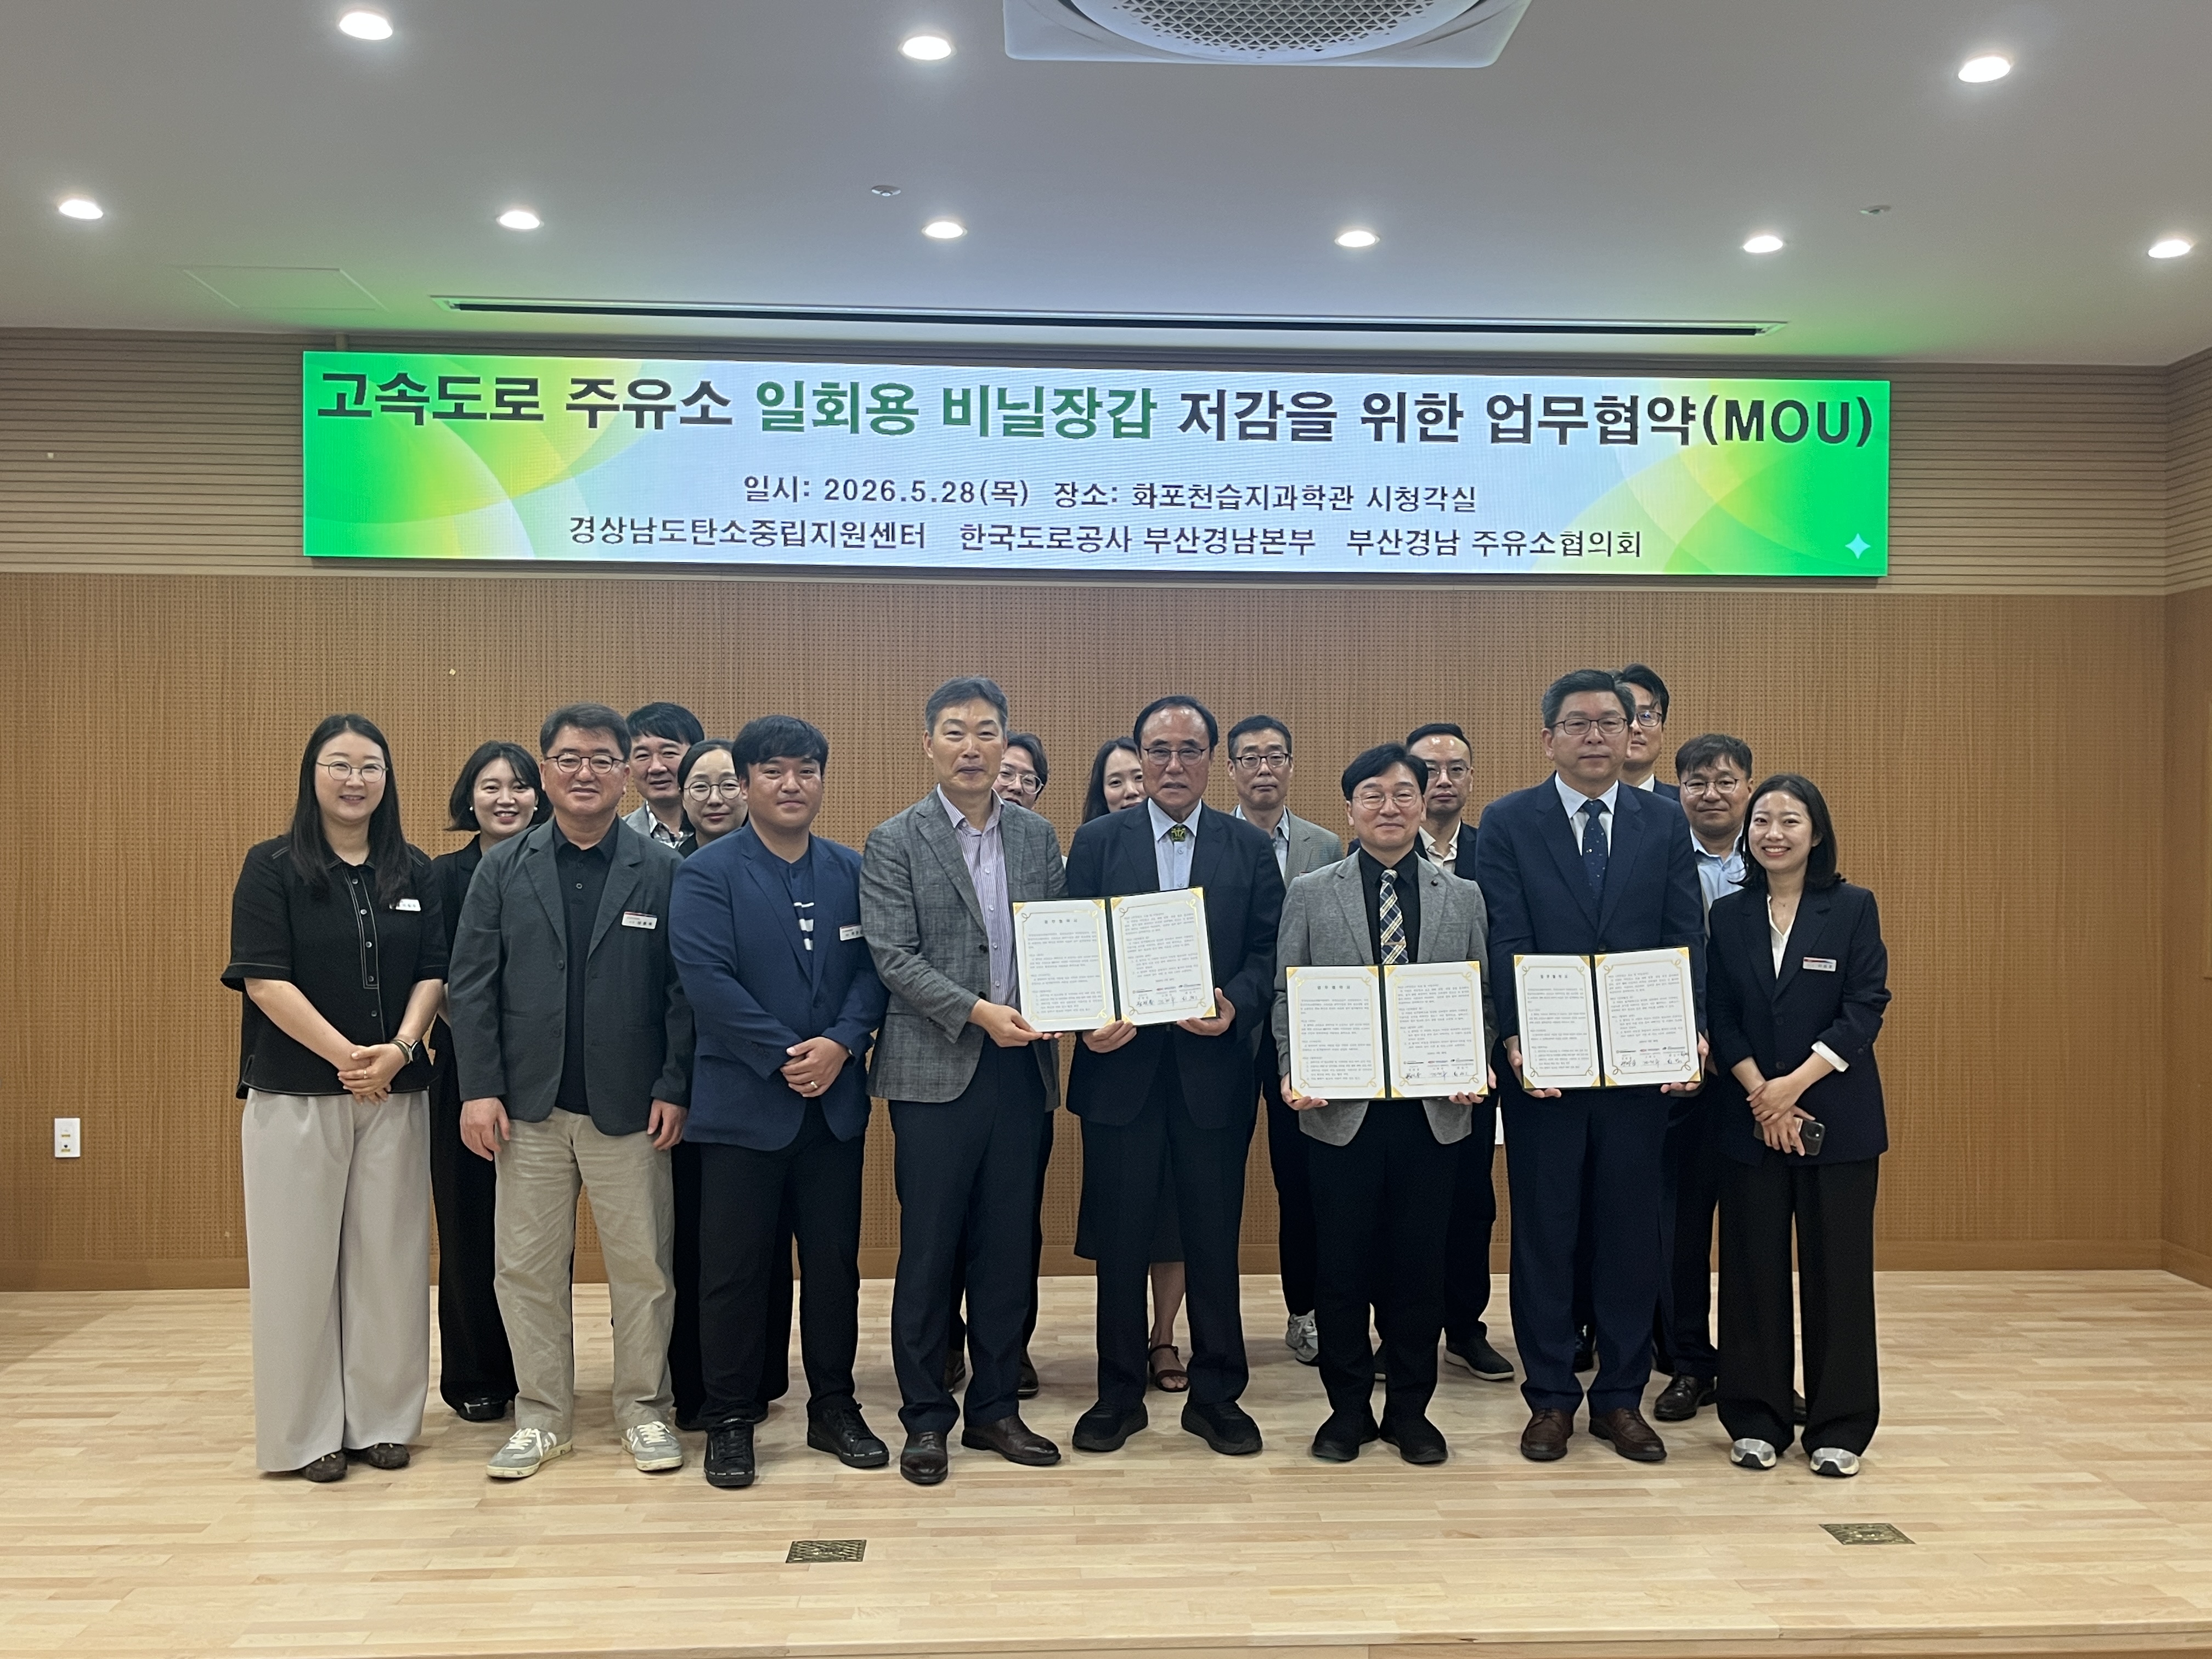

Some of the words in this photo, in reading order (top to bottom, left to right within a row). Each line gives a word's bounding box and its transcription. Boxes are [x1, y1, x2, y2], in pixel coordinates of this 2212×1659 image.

[317, 372, 545, 426] 고속도로
[565, 377, 733, 430] 주유소
[755, 380, 919, 436] 일회용
[942, 384, 1158, 440] 비닐장갑
[1177, 388, 1338, 442] 저감을
[1360, 391, 1465, 444] 위한
[1486, 392, 1873, 448] 업무협약(MOU)
[743, 475, 810, 503] 일시:
[823, 477, 1029, 507] 2026.5.28(목)
[1053, 481, 1118, 509] 장소:
[1131, 482, 1355, 511] 화포천습지과학관
[1366, 485, 1476, 513] 시청각실
[569, 516, 925, 549] 경상남도탄소중립지원센터
[959, 522, 1132, 553] 한국도로공사
[1143, 526, 1316, 556] 부산경남본부
[1346, 528, 1461, 557] 부산경남
[1471, 530, 1641, 558] 주유소협의회
